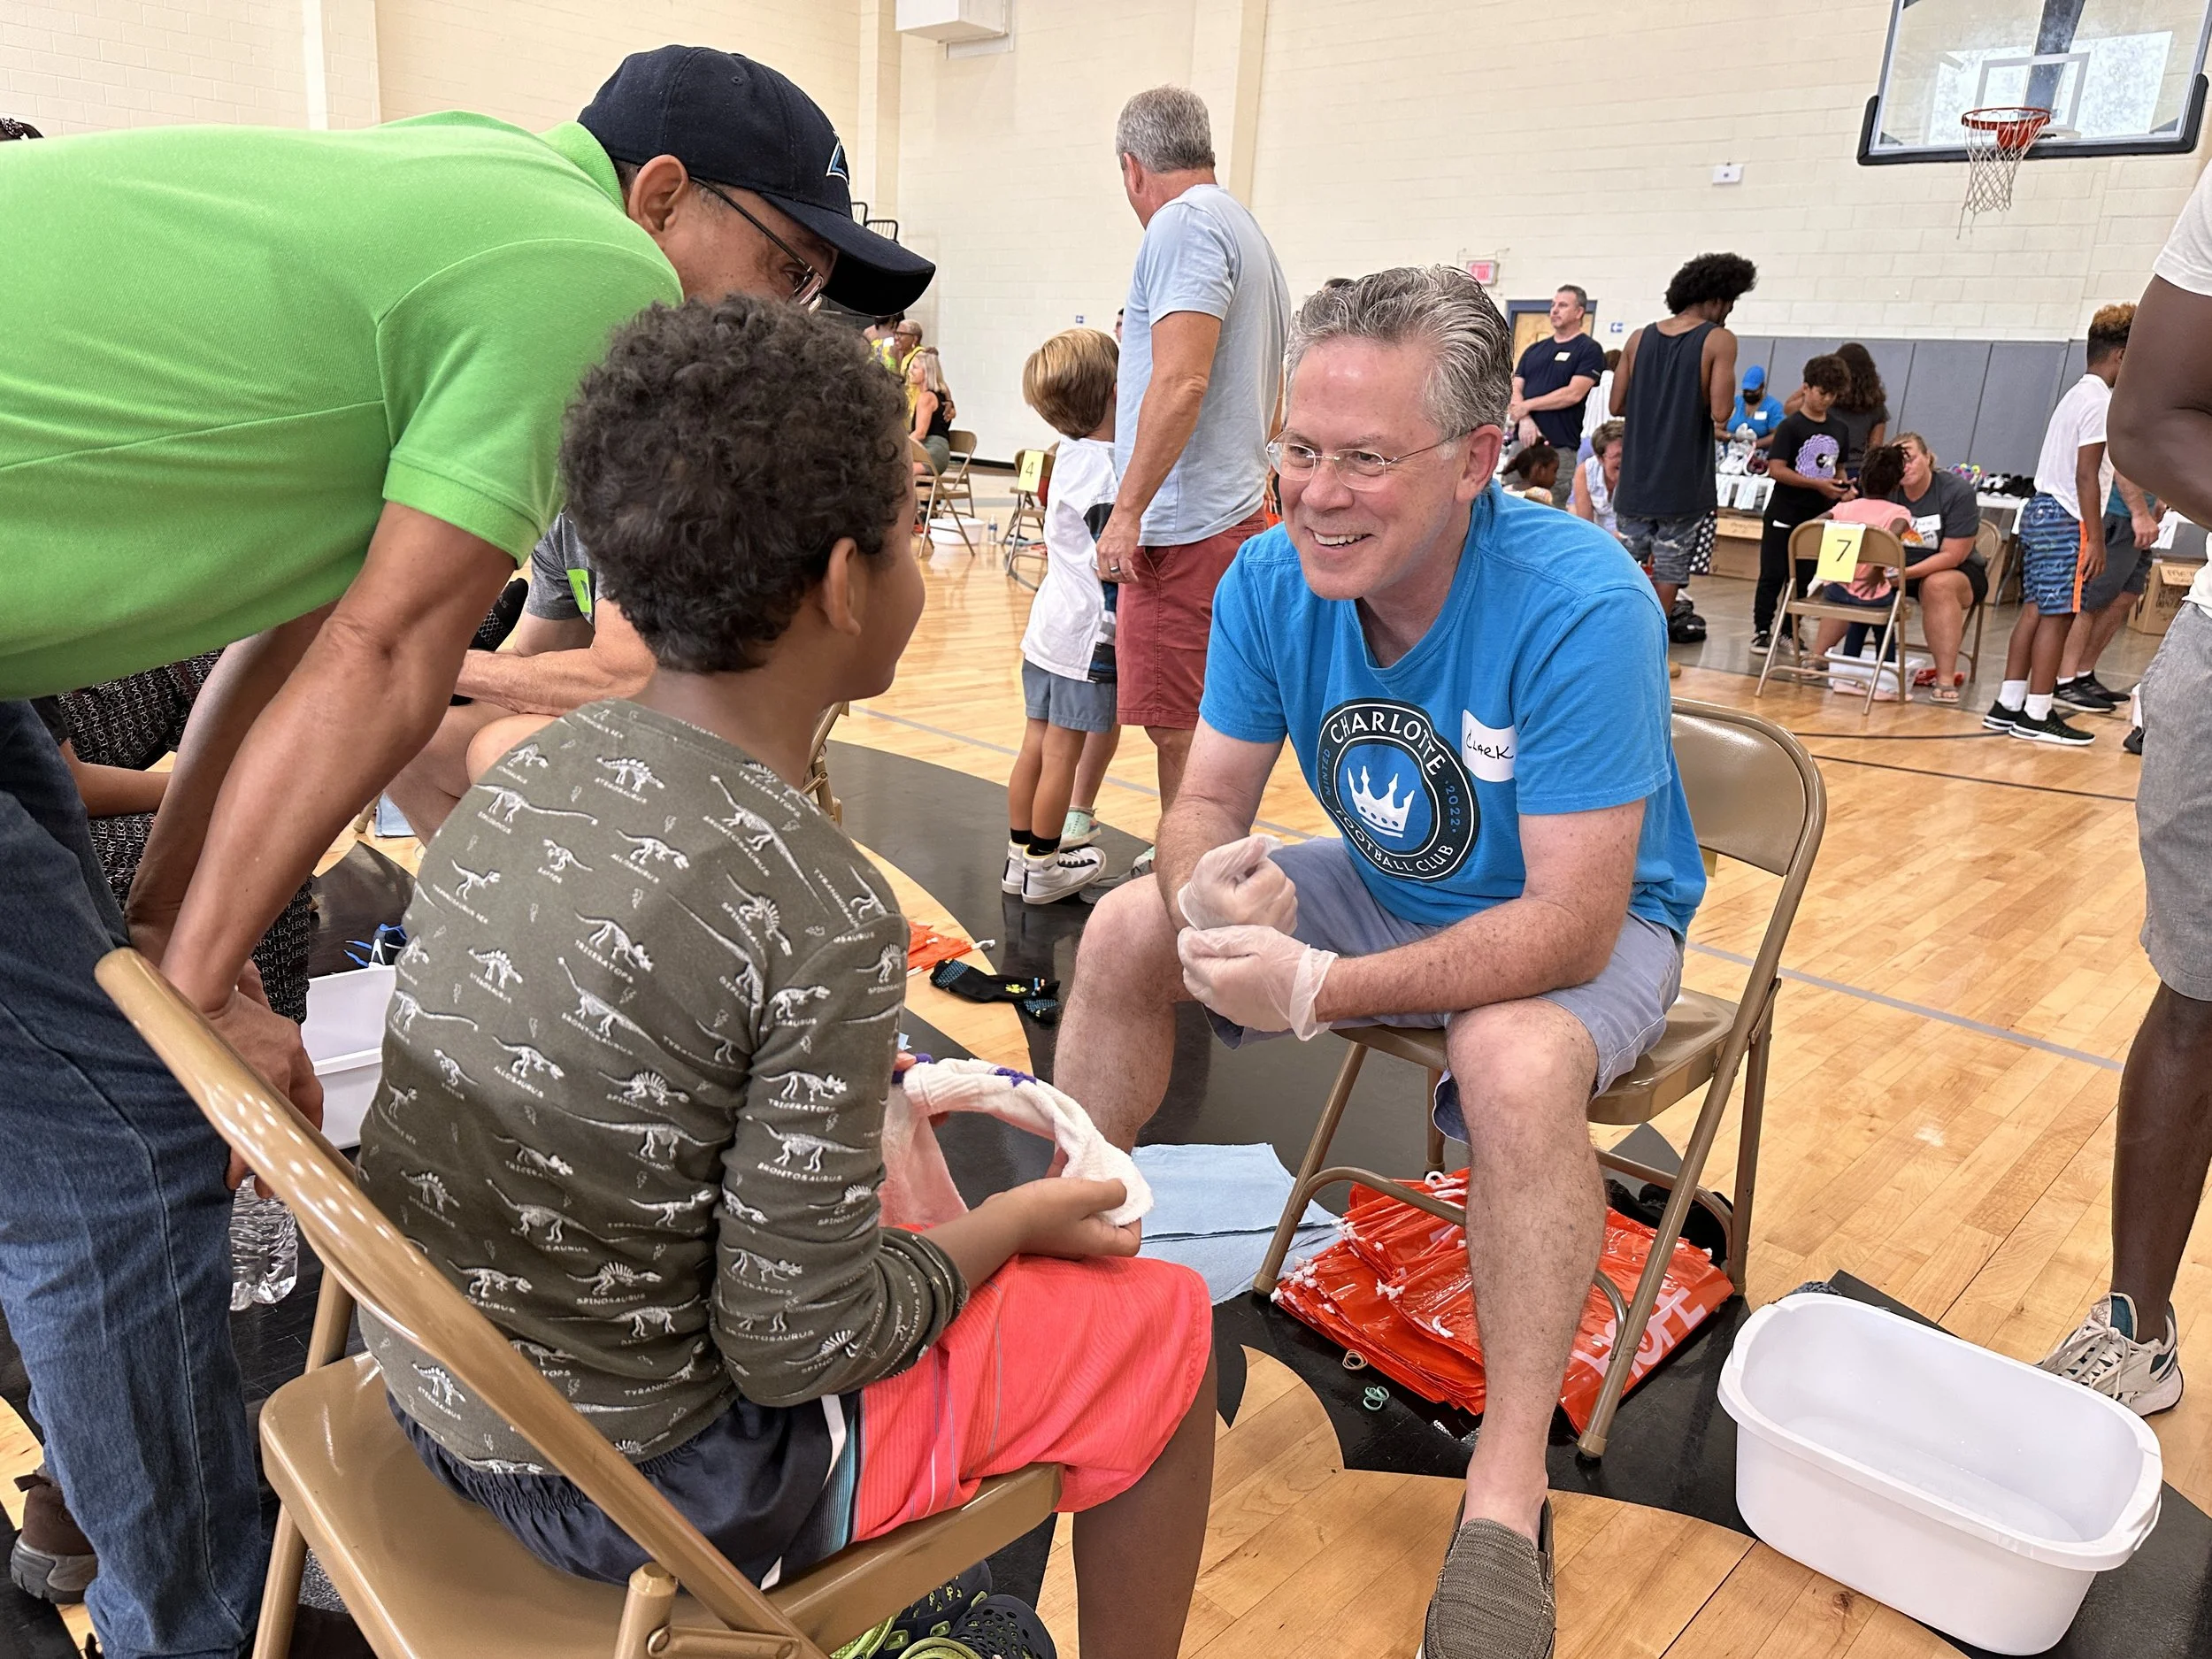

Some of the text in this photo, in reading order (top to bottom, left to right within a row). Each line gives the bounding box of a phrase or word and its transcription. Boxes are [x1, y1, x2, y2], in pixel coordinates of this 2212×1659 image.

[1025, 461, 1034, 478] 4
[1836, 539, 1852, 562] 7
[1330, 710, 1447, 776] CHARLOTTE
[1465, 729, 1514, 760] CLARK
[1321, 749, 1332, 795] MINTED
[1336, 809, 1454, 872] FOOTBALL CLUB
[494, 1065, 545, 1100] ALLOSAURUS
[757, 1161, 843, 1183] BRONTOSAURUS
[575, 1292, 646, 1306] SPINOSAURUS
[417, 1386, 462, 1421] STEGOSAURUS
